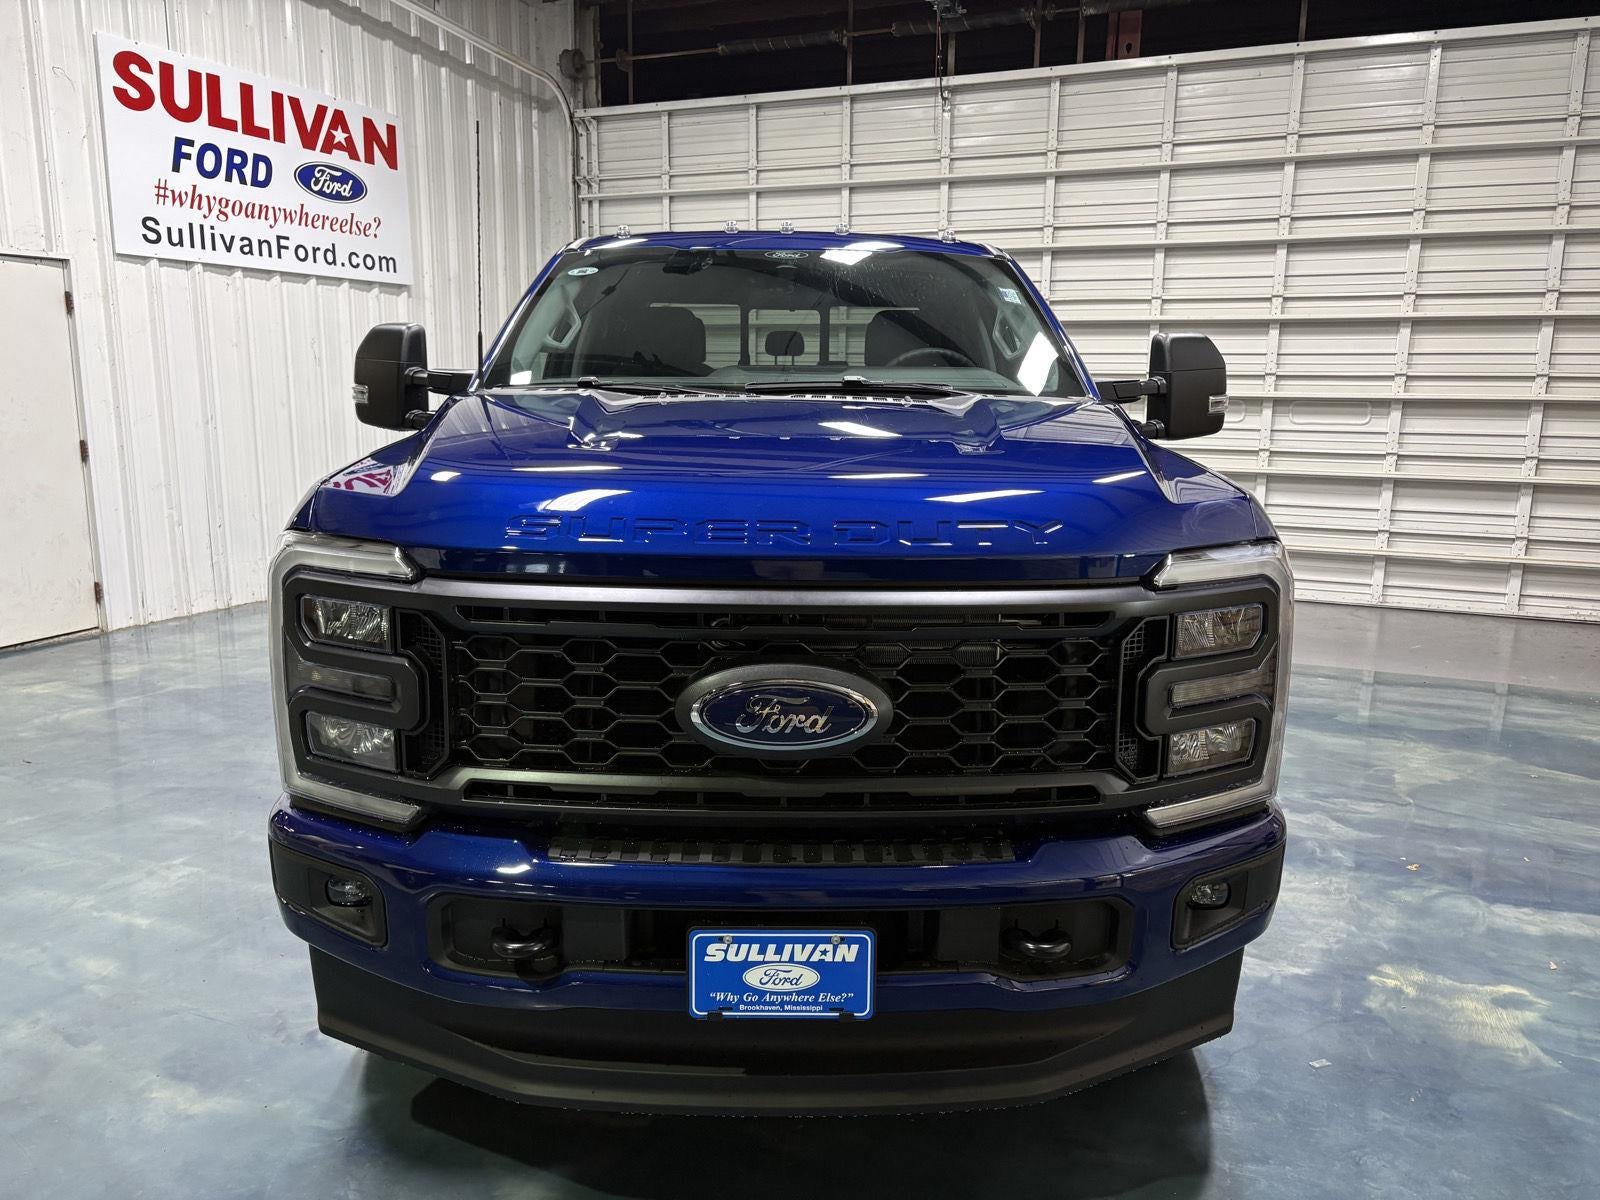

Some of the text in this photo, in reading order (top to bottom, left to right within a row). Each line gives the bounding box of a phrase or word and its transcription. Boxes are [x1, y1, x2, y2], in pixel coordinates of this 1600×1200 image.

[112, 50, 398, 171] SULLIVAN
[171, 136, 273, 189] FORD
[310, 165, 353, 199] Ford
[154, 178, 382, 239] #whygoanywhereelse?
[141, 216, 398, 274] SullivanFord.com
[505, 514, 1064, 546] SUPER DUTY
[735, 694, 835, 734] Ford
[704, 943, 859, 962] SULLIVAN
[759, 968, 804, 986] Ford
[739, 1004, 823, 1012] Brookhaven, Mississippi
[743, 992, 759, 1002] Go
[761, 992, 815, 1004] Anywhere
